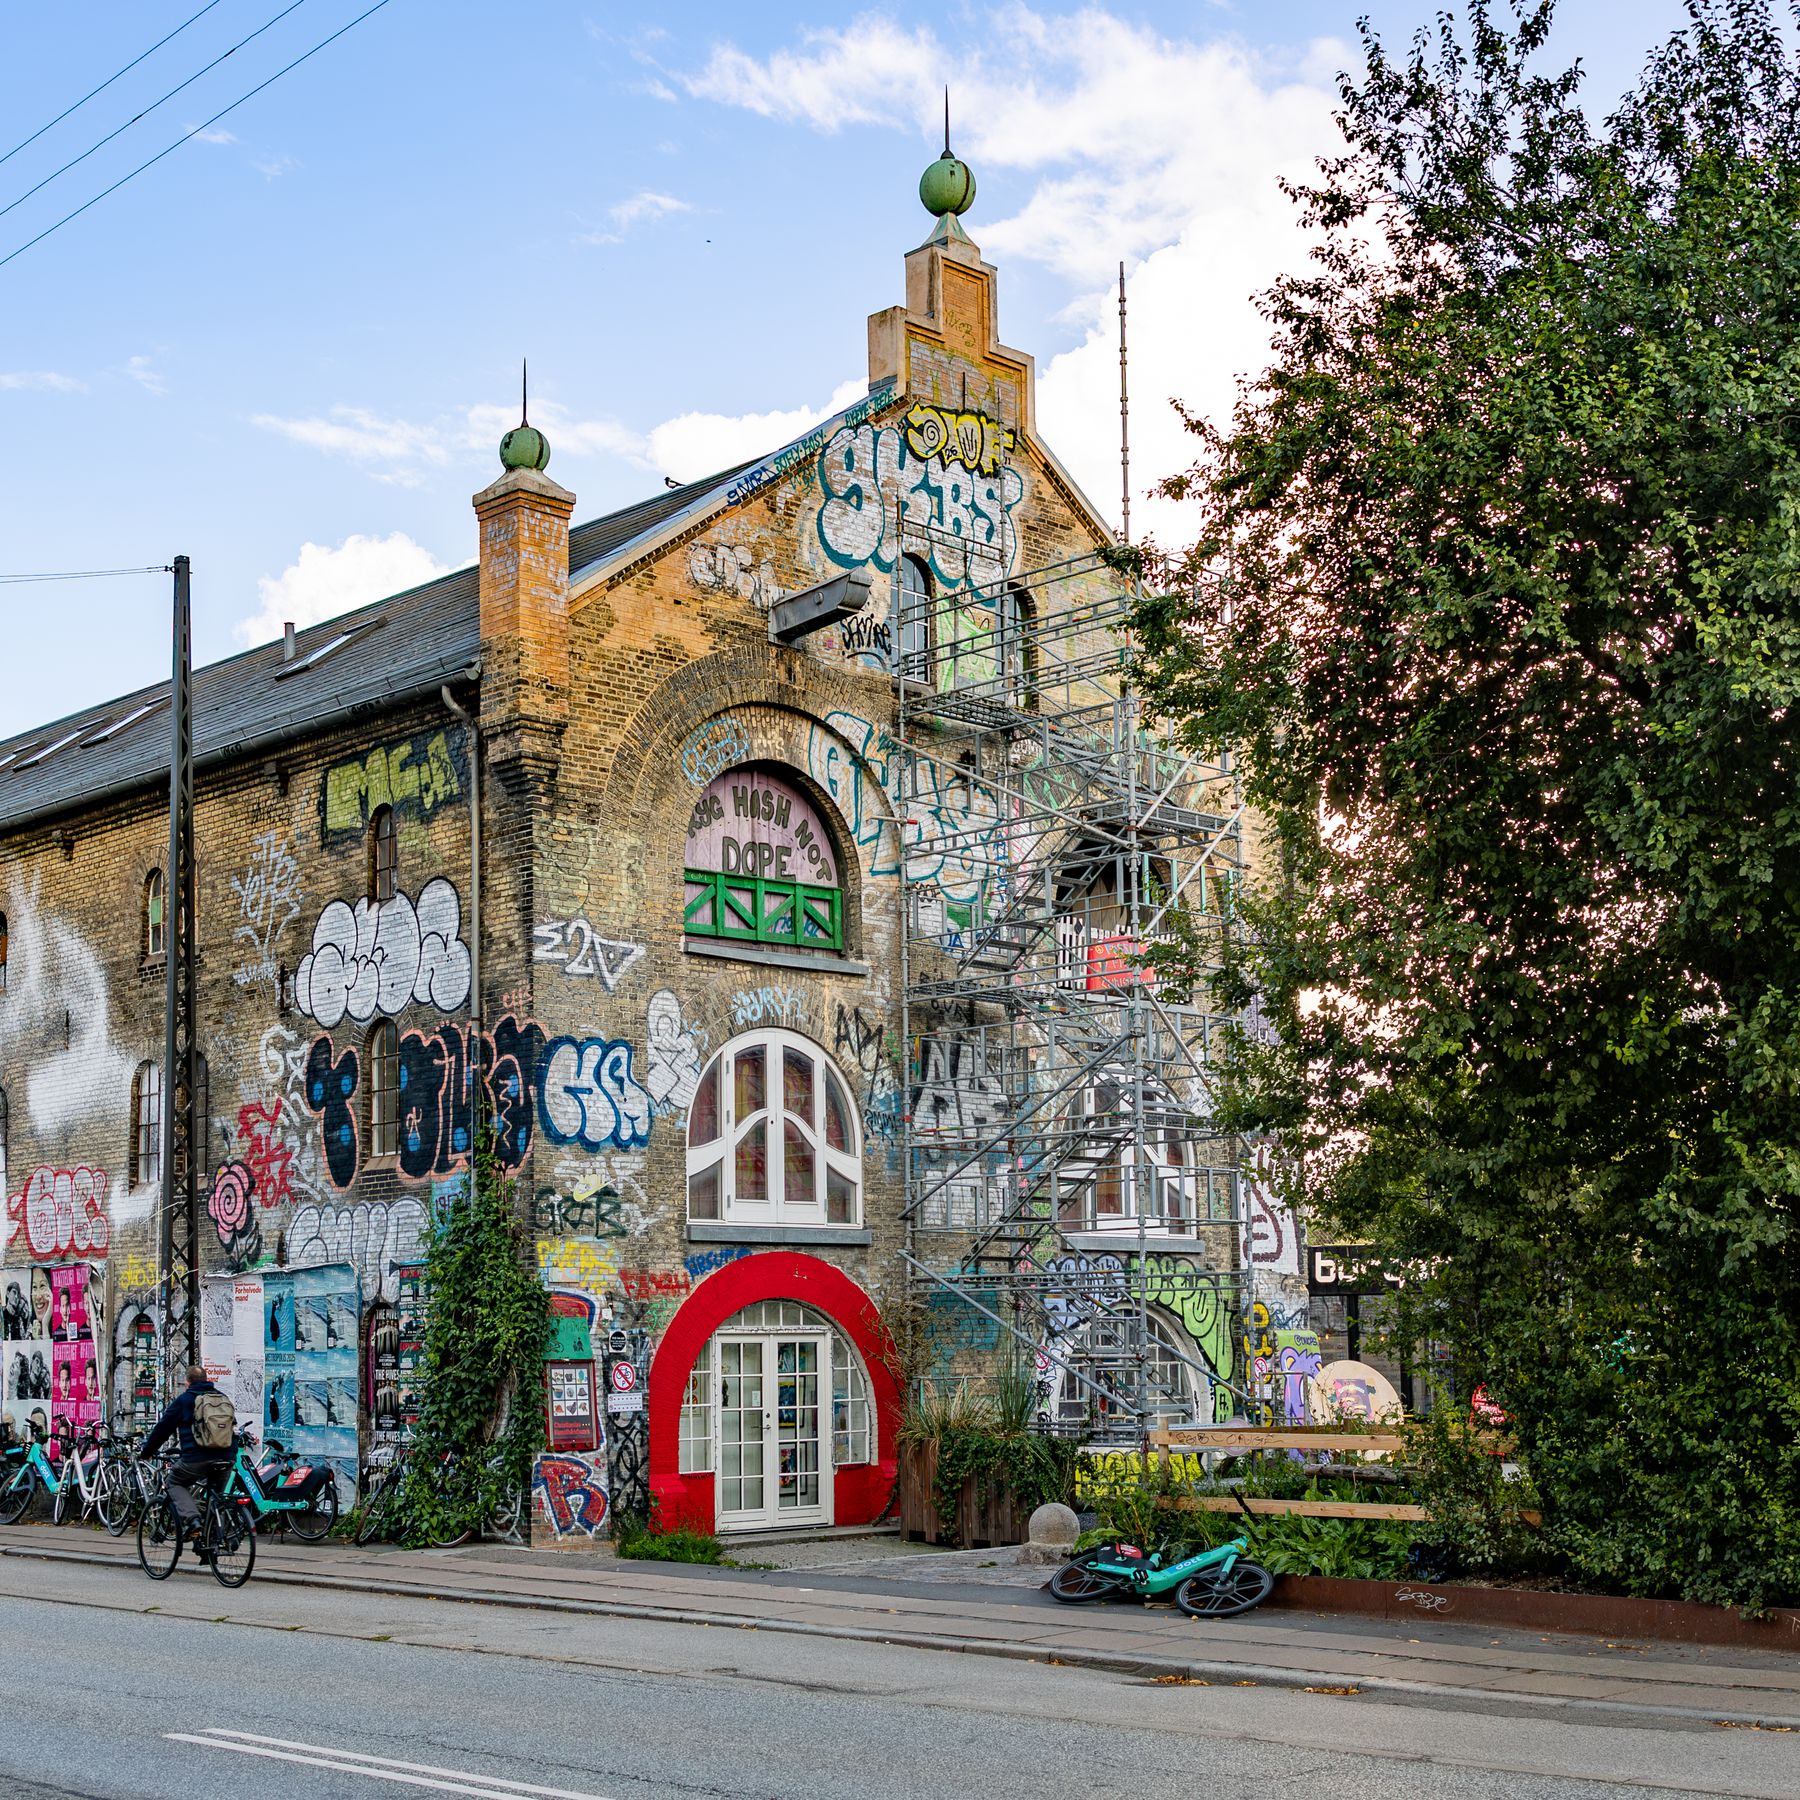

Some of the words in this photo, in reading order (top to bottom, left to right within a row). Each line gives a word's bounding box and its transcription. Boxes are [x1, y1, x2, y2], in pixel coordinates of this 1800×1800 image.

[945, 445, 957, 459] 26
[732, 786, 792, 829] HASH
[795, 820, 833, 882] NOT
[722, 836, 796, 882] DOPE
[40, 1464, 51, 1480] dott
[244, 1475, 257, 1495] dott
[1175, 1557, 1203, 1571] dott
